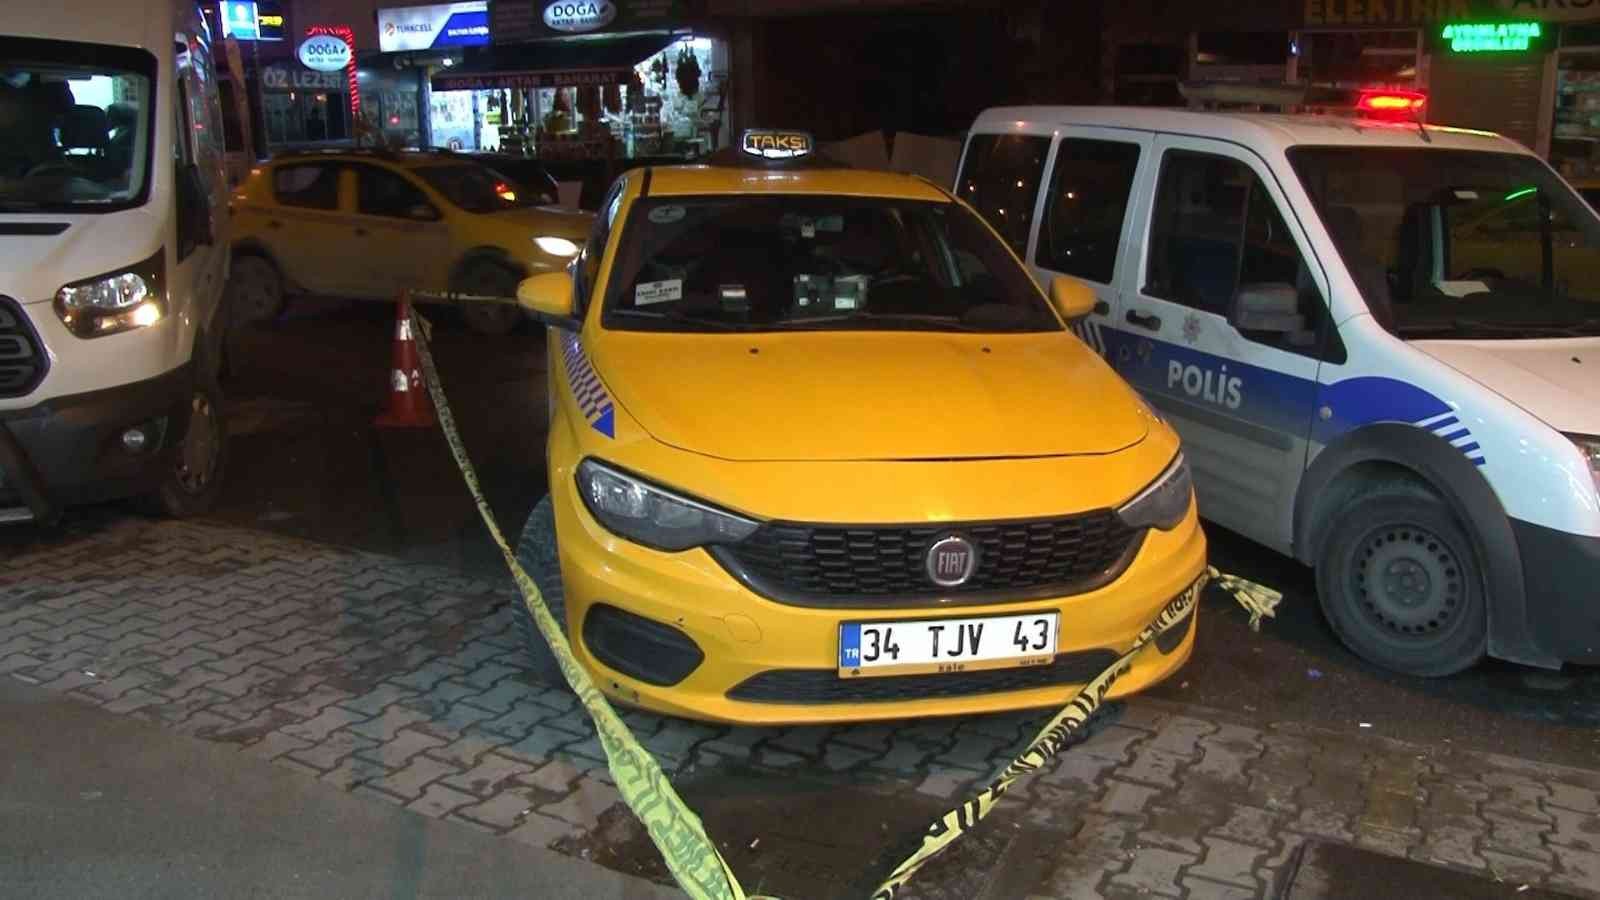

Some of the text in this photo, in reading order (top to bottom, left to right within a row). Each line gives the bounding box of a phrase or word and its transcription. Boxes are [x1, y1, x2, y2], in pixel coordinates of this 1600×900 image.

[553, 1, 598, 17] DOĞA
[396, 23, 433, 33] TURKCELL
[308, 43, 338, 55] DOĞA
[263, 67, 288, 87] ÖZ
[1167, 359, 1242, 410] POLİS
[937, 550, 966, 574] FIAT
[863, 619, 1049, 662] 34 TJV 43
[844, 648, 860, 659] TR
